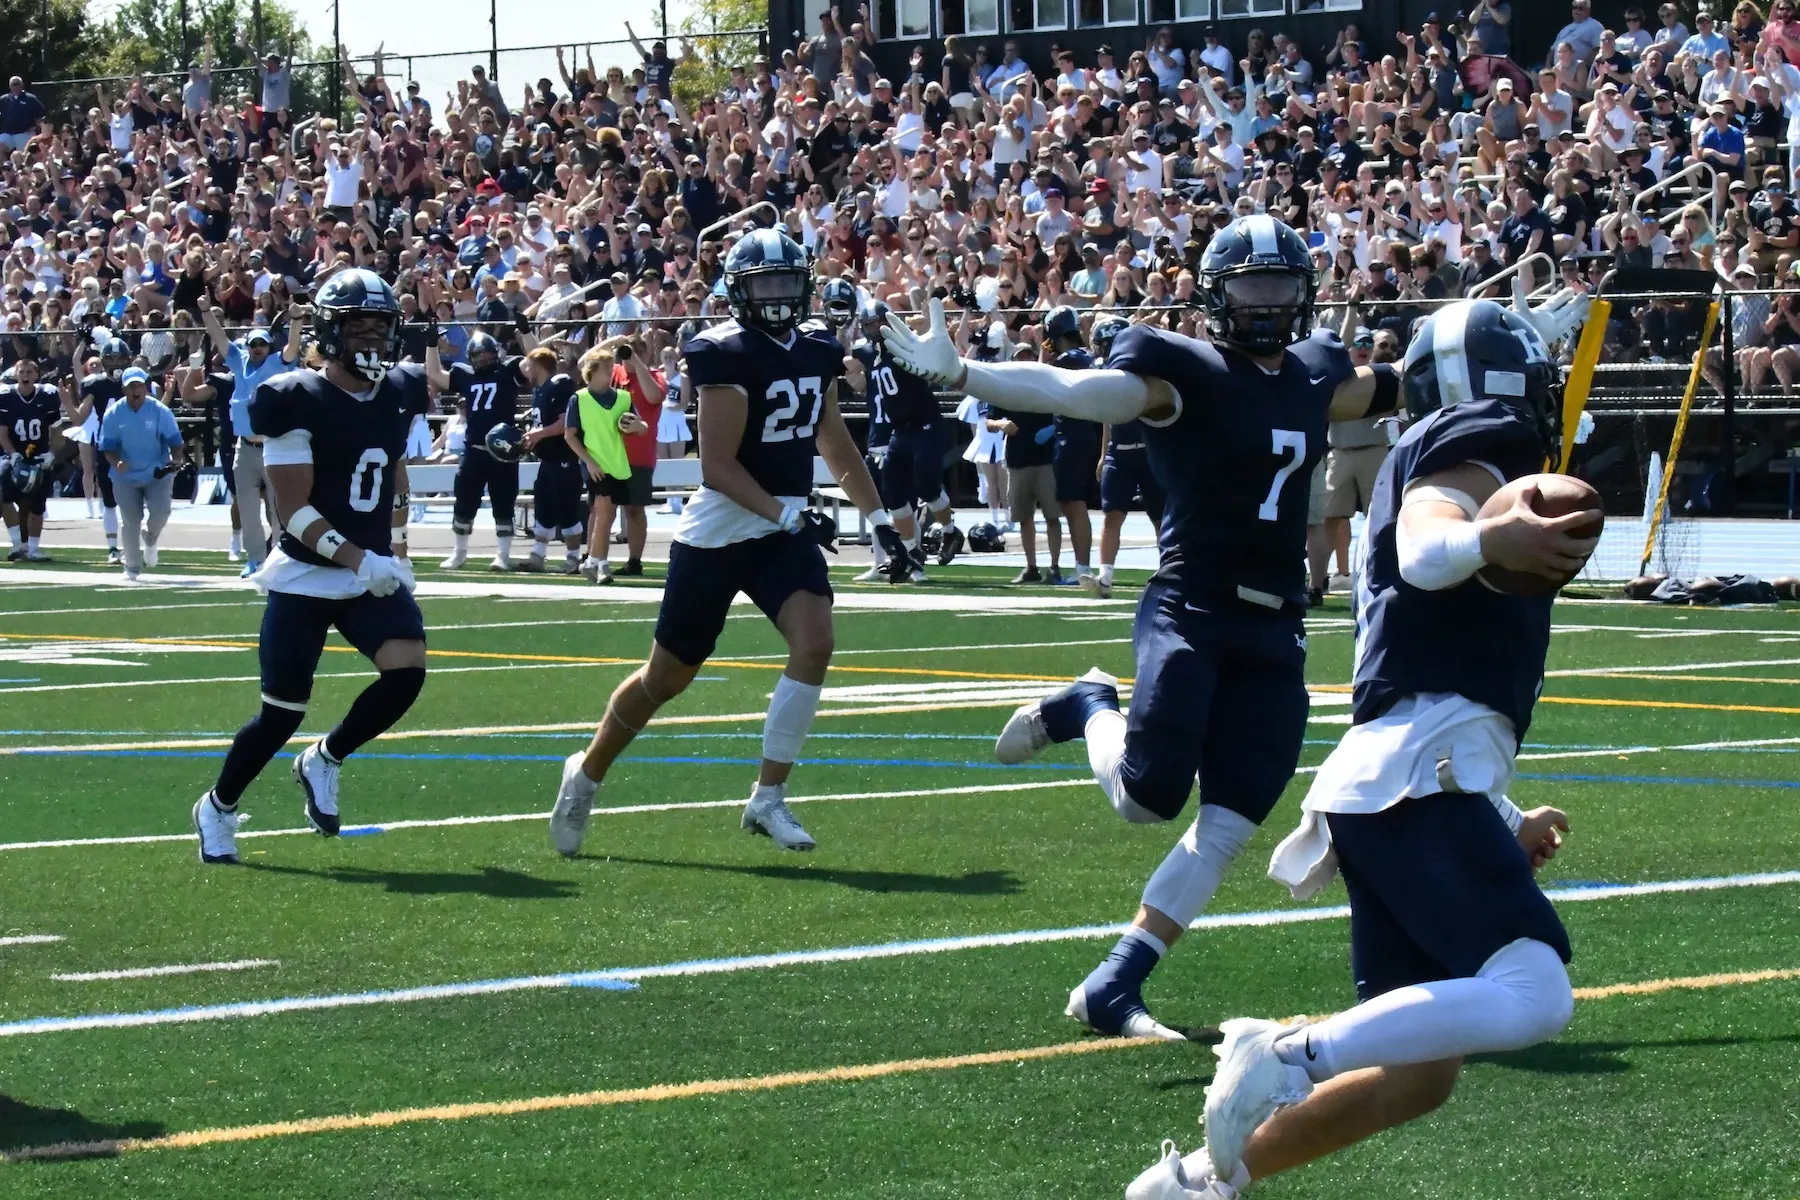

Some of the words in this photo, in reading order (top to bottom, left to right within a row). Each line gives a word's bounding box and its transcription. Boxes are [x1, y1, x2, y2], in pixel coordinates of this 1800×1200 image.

[470, 382, 497, 411] 77
[871, 366, 899, 399] 70
[14, 418, 41, 441] 40
[761, 376, 822, 442] 27
[349, 447, 388, 512] 0
[1258, 428, 1307, 521] 7
